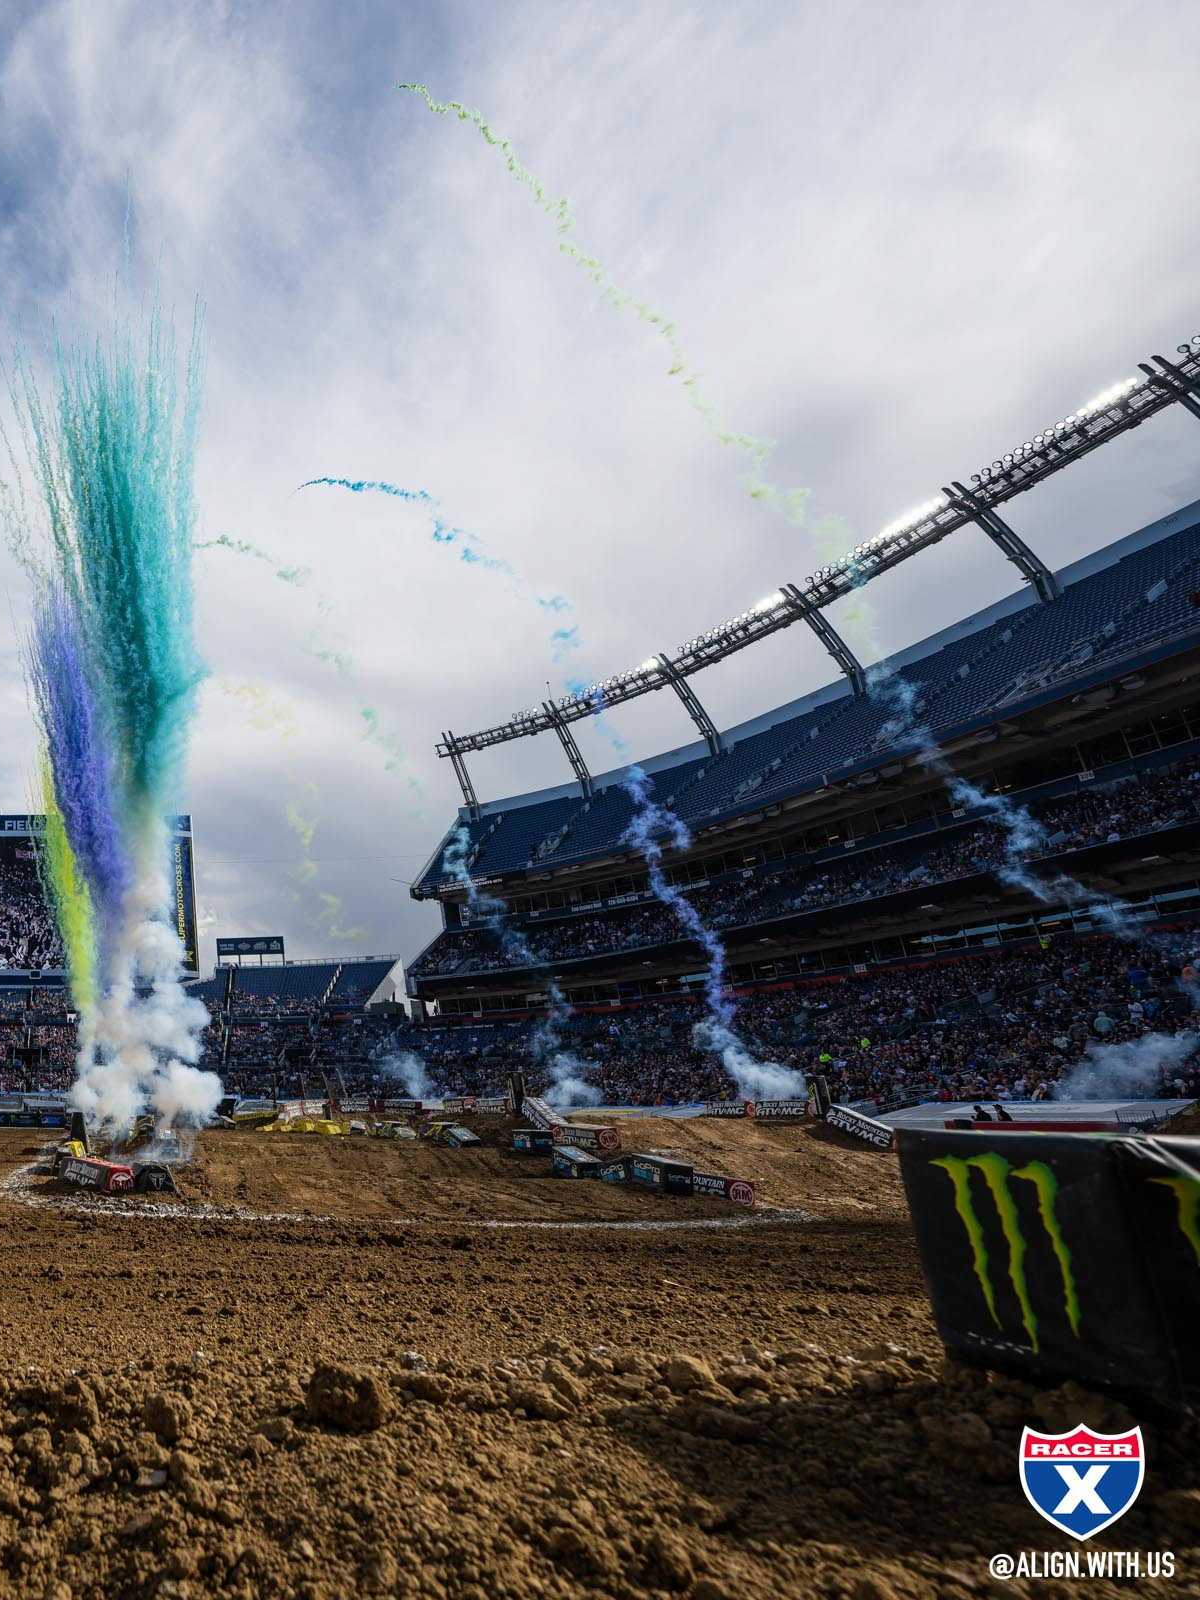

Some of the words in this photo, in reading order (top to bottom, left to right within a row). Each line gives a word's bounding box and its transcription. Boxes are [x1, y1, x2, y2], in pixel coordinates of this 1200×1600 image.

[4, 820, 45, 830] FIELD
[837, 1112, 856, 1128] ROCKY
[856, 1120, 891, 1140] MOUNTAIN
[600, 1163, 624, 1176] GoPro
[633, 1159, 660, 1174] GoPro
[692, 1174, 725, 1189] OUNTAIN
